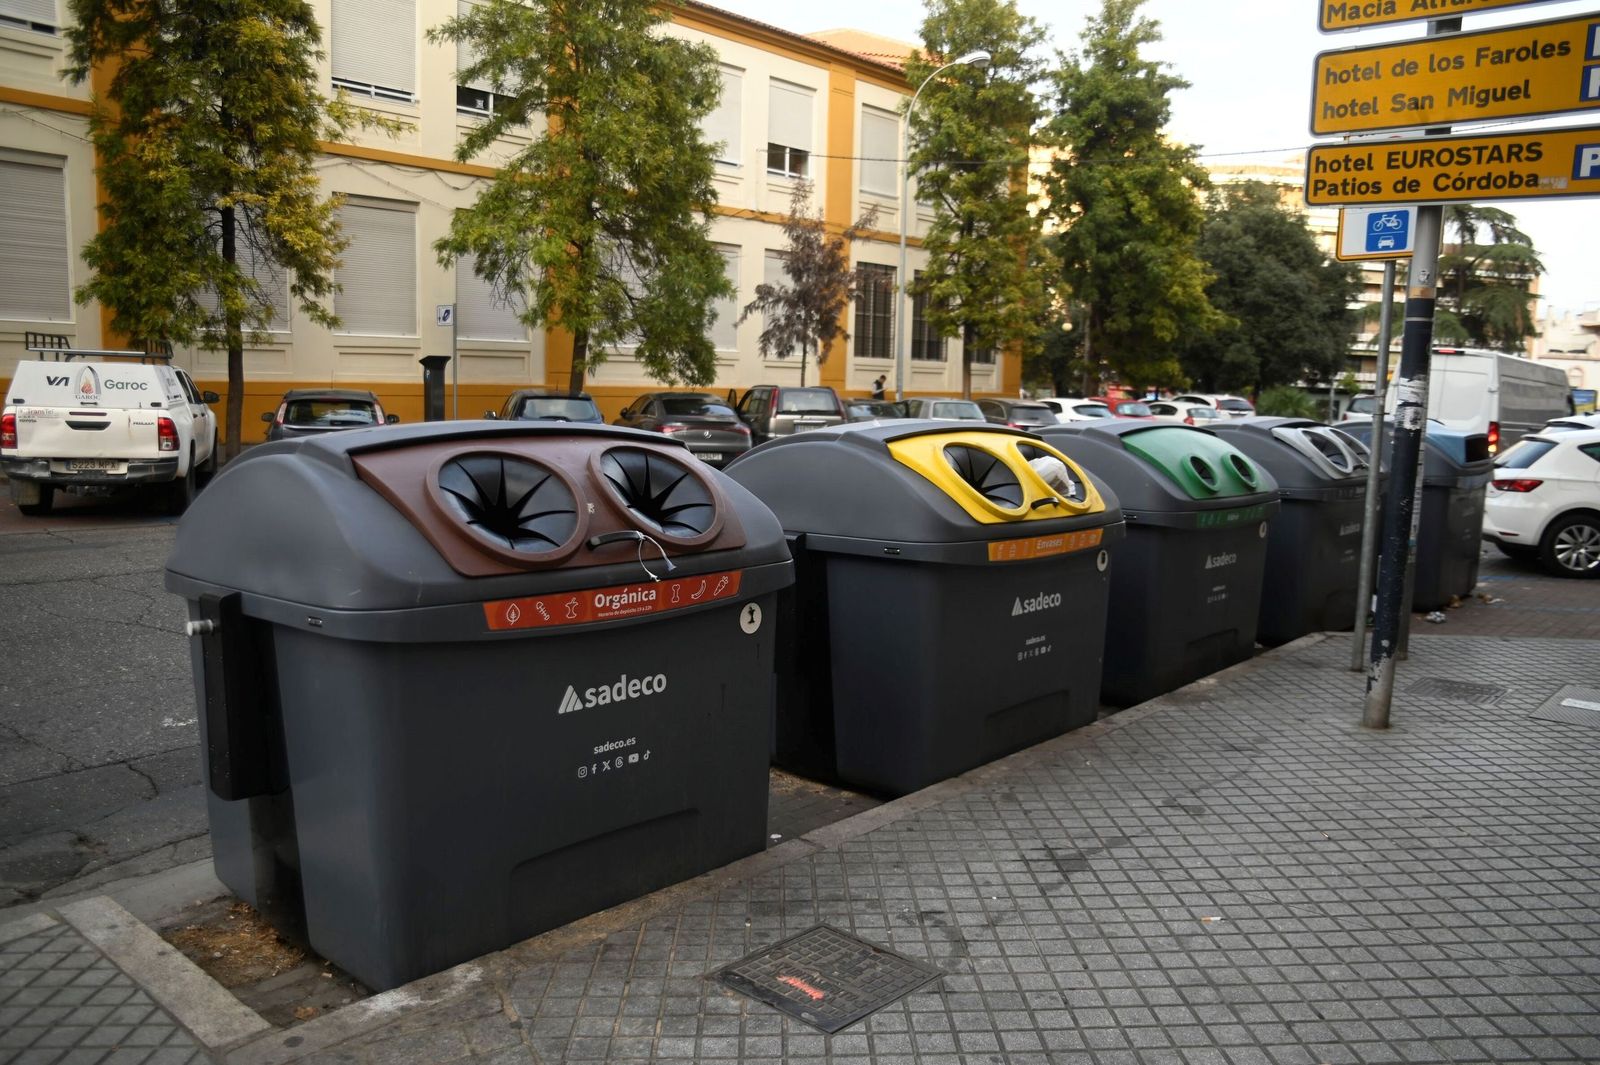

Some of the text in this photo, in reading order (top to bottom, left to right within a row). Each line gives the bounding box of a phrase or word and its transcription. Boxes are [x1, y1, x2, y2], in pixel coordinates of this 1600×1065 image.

[1325, 61, 1382, 86] hotel
[1391, 59, 1419, 78] de
[1429, 54, 1465, 73] los
[1475, 40, 1571, 67] Faroles
[1322, 79, 1531, 120] hotel San Miguel
[1315, 153, 1374, 174] hotel
[1386, 142, 1543, 170] EUROSTARS
[1313, 177, 1383, 197] Patios
[1392, 176, 1421, 194] de
[1433, 171, 1540, 192] Córdoba
[104, 379, 149, 391] Garoc
[1212, 552, 1237, 568] sadeco
[595, 587, 656, 610] Orgánica
[1023, 592, 1061, 614] sadeco
[584, 673, 667, 708] sadeco
[593, 736, 636, 754] sadeco.es
